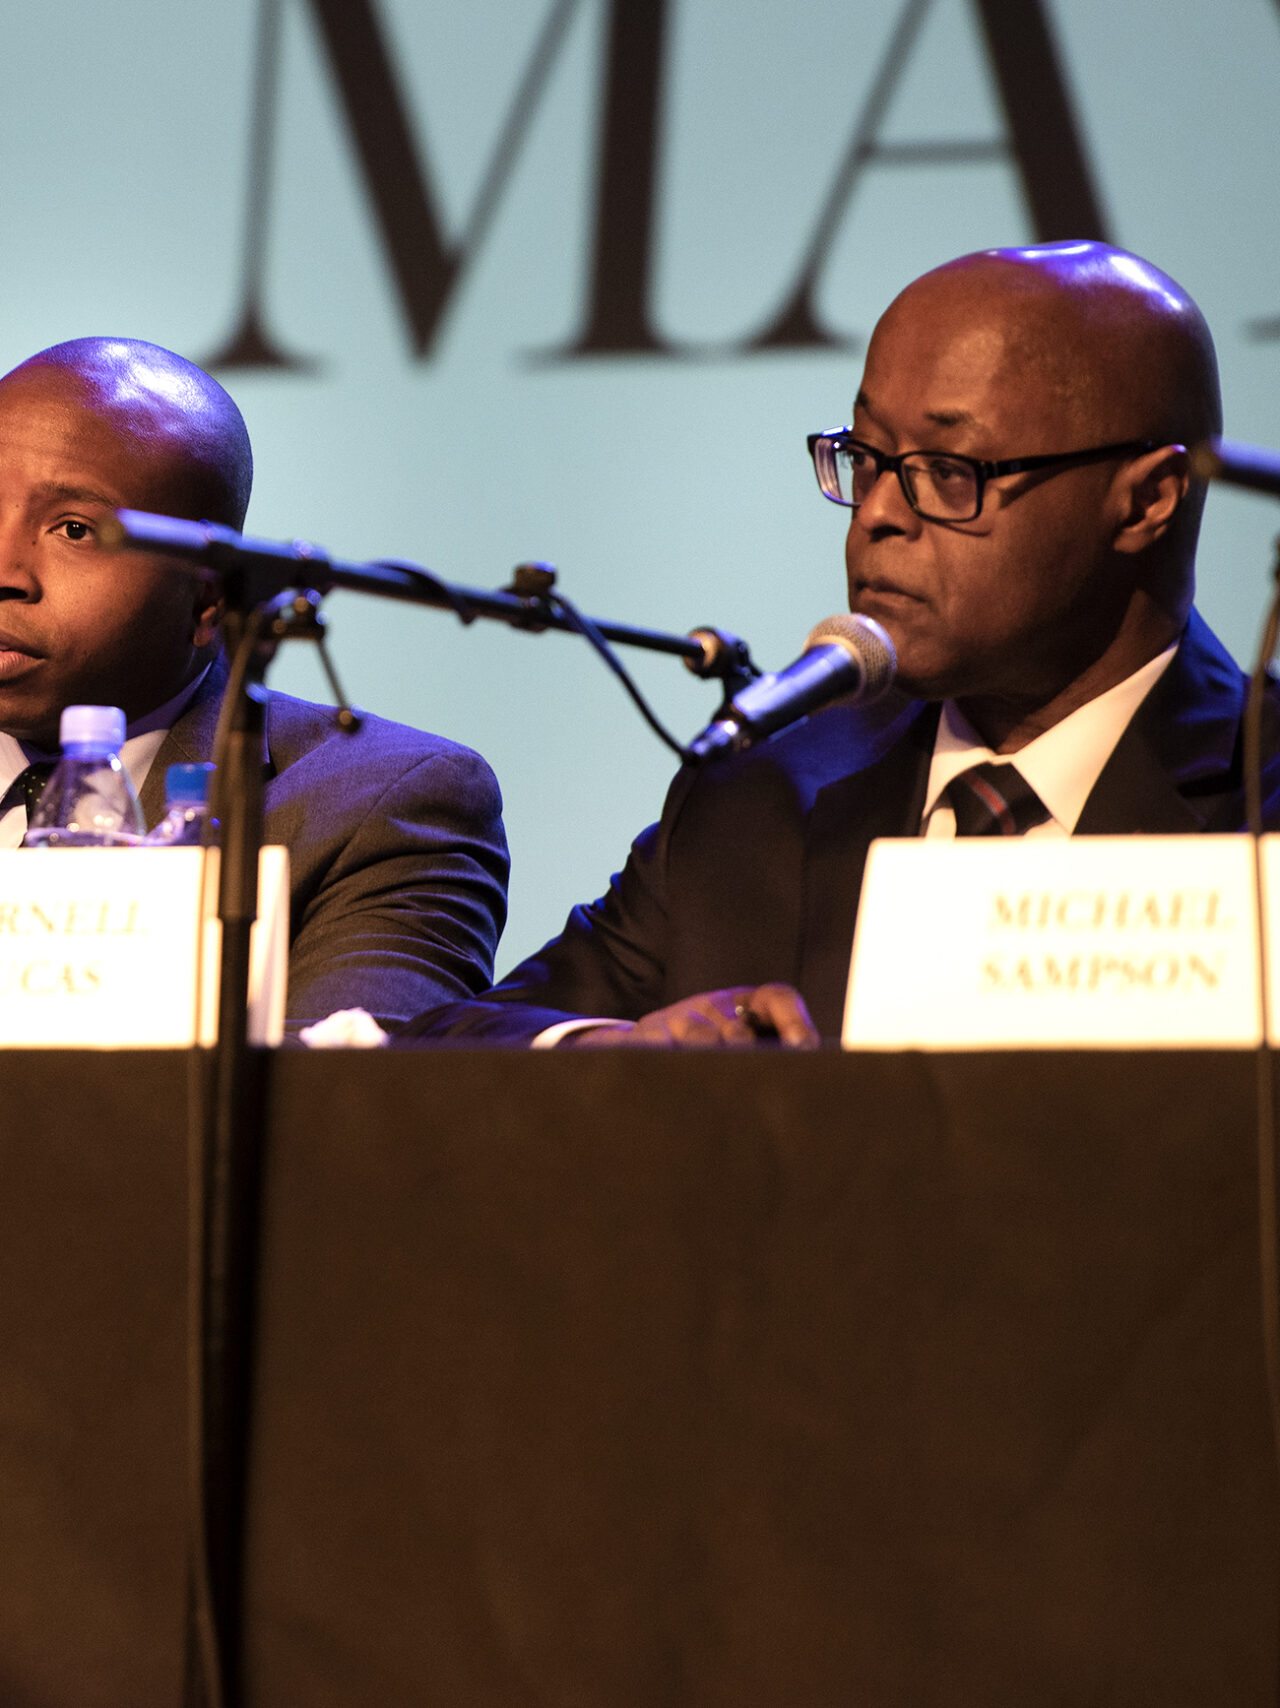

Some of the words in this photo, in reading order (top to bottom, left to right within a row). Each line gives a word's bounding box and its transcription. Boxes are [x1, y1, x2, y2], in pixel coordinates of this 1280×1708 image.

[200, 0, 1280, 374] MA
[992, 891, 1233, 930] MICHAEL
[981, 951, 1224, 991] SAMPSON
